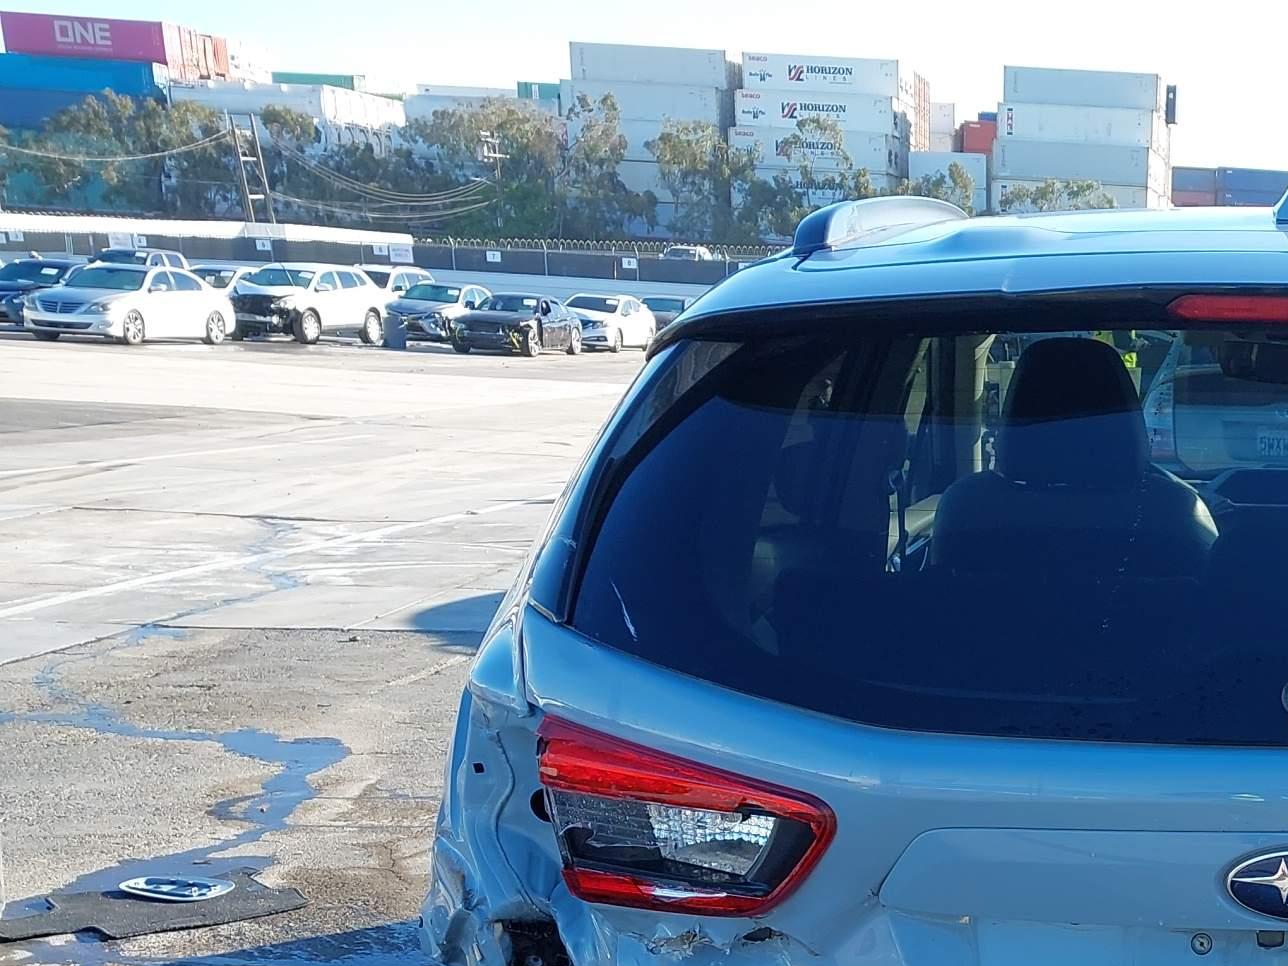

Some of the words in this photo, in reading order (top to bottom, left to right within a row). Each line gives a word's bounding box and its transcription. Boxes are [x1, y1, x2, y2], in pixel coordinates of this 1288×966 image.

[54, 19, 112, 45] ONE
[806, 65, 853, 75] HORIZON
[800, 103, 846, 113] HORIZON
